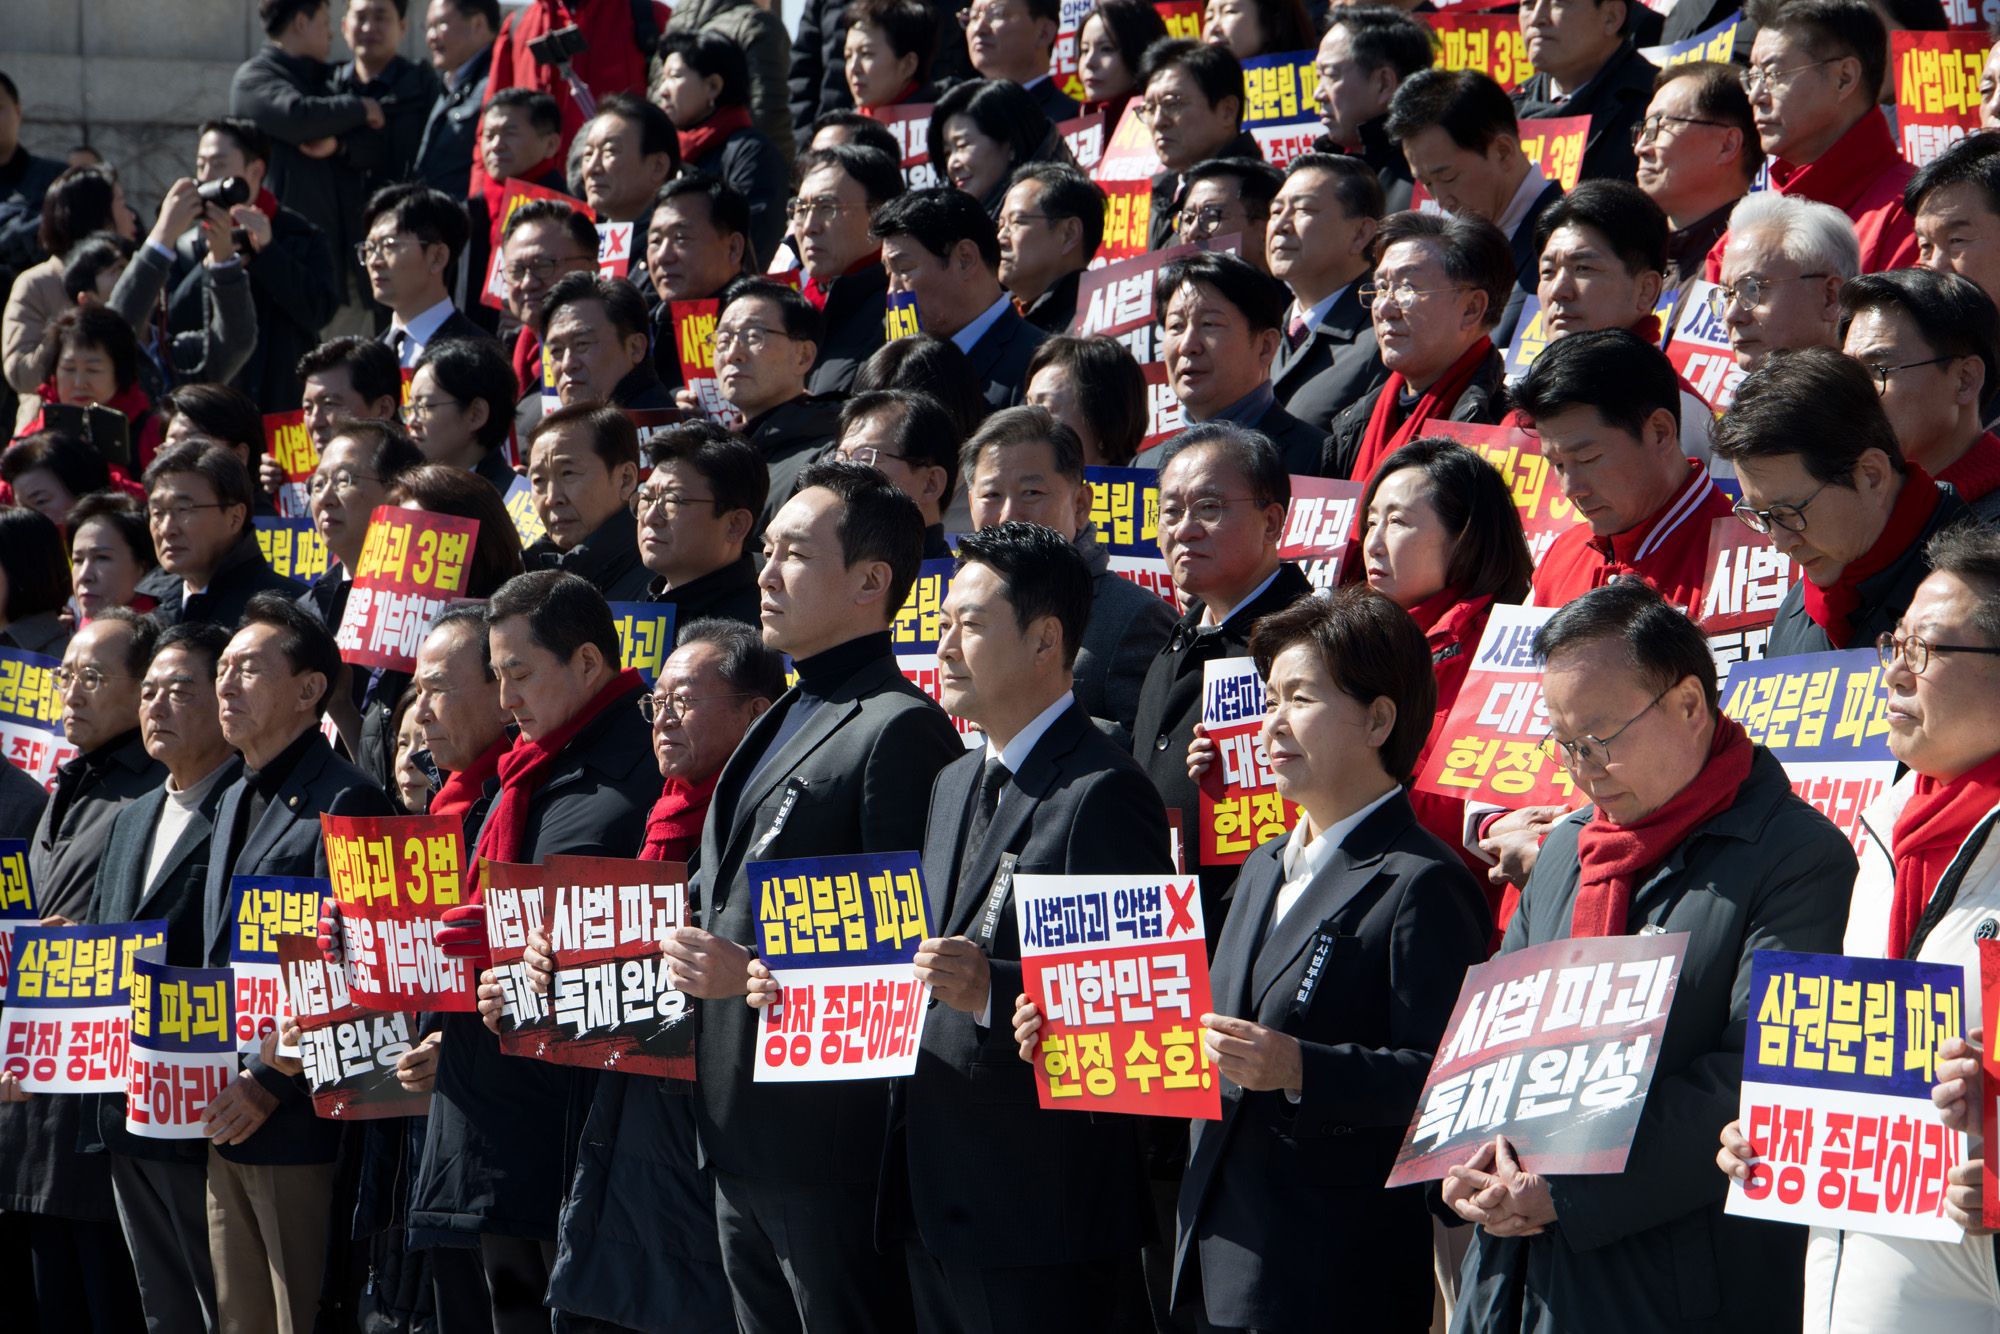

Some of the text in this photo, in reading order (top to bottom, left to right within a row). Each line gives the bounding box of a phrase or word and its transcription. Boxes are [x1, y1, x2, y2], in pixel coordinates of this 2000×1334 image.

[1243, 63, 1298, 121] 권분립
[1546, 131, 1585, 190] 3법
[1082, 268, 1155, 338] 사법
[1284, 497, 1357, 550] 파괴
[412, 529, 470, 592] 3법
[1702, 545, 1791, 617] 사법
[1437, 735, 1555, 795] 헌정
[1213, 791, 1289, 855] 헌정
[404, 832, 460, 906] 3법
[485, 887, 527, 949] 사법
[550, 882, 686, 952] 사법 파괴
[760, 868, 929, 956] 삼권분립 파괴
[1023, 885, 1163, 949] 사법파괴 악법
[16, 936, 117, 998] 삼권분립
[288, 959, 330, 1017] 사법
[552, 962, 622, 1038] 독재
[1041, 953, 1191, 1027] 대한민국
[159, 980, 228, 1043] 파괴
[236, 977, 278, 1042] 당장
[764, 979, 925, 1068] 당장 중단하라!
[1439, 955, 1677, 1065] 사법 파괴
[1757, 973, 1895, 1077] 삼권분립
[4, 1020, 63, 1082] 당장
[336, 1012, 414, 1078] 완성
[1041, 1025, 1212, 1098] 헌정 수호!
[1412, 1034, 1652, 1151] 독재 완성
[1743, 1104, 1814, 1205] 당장
